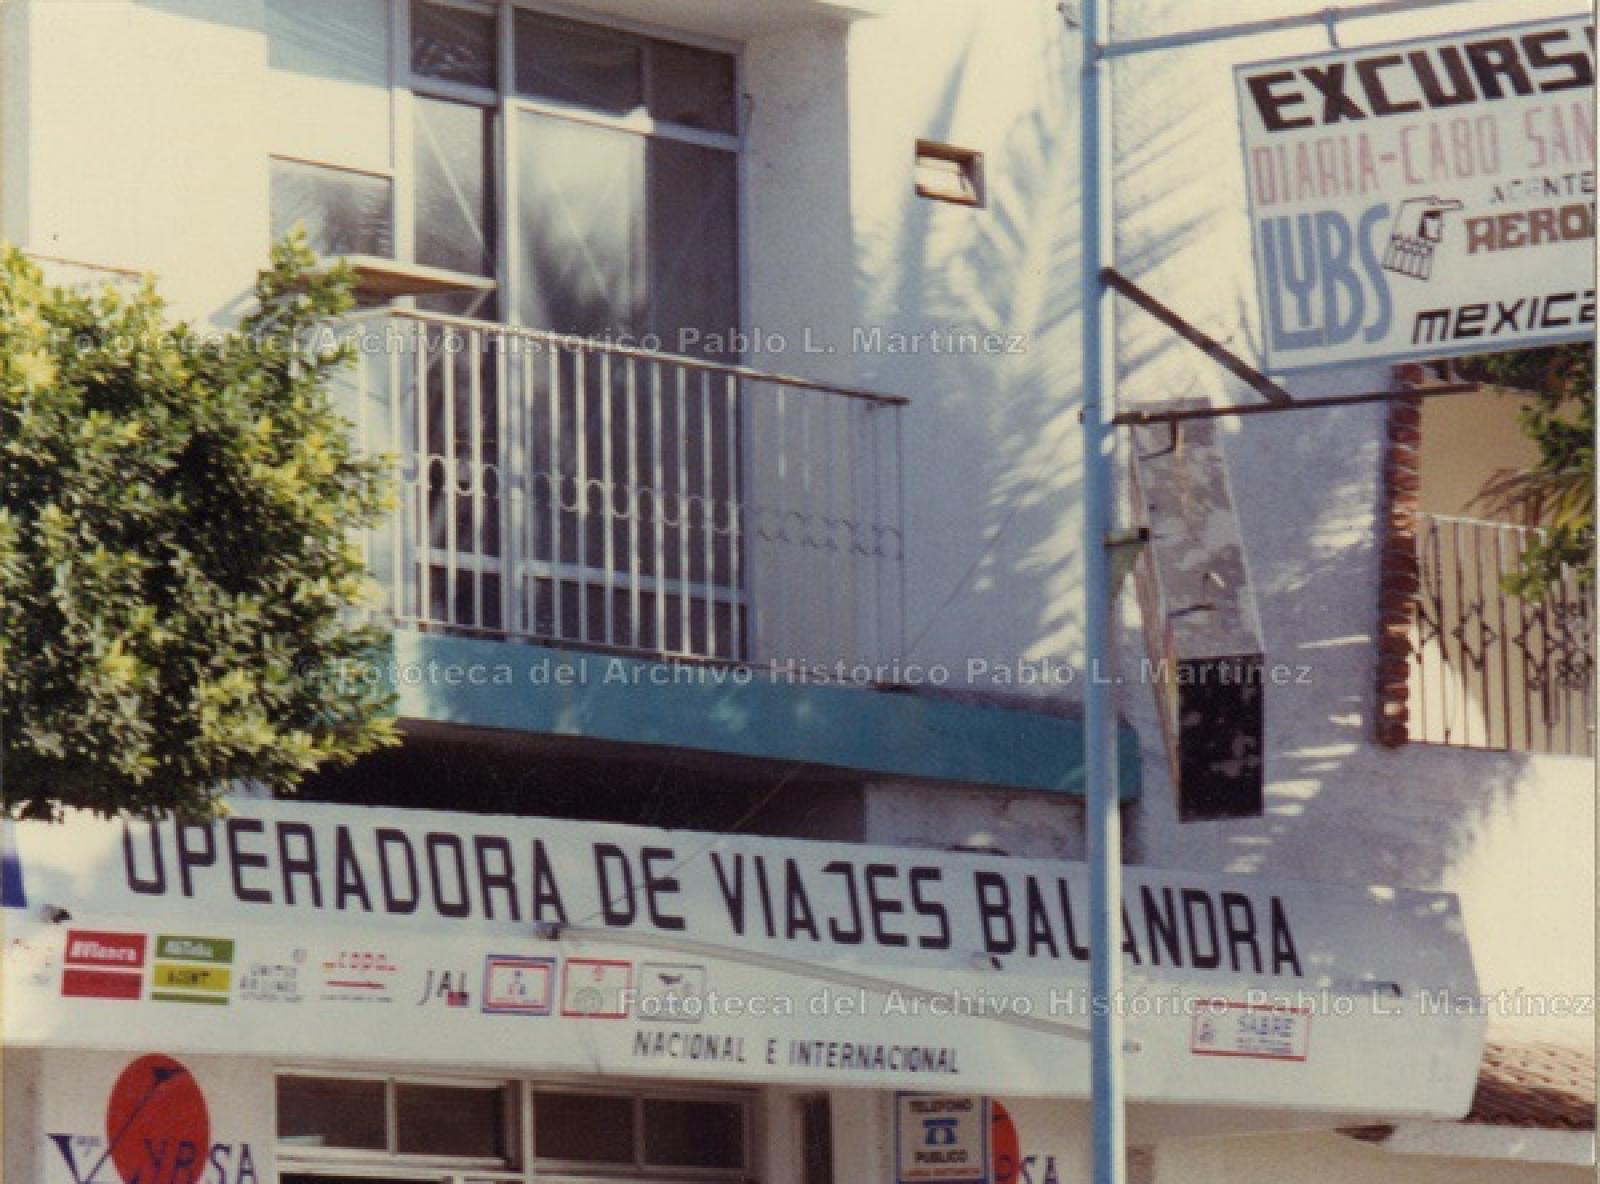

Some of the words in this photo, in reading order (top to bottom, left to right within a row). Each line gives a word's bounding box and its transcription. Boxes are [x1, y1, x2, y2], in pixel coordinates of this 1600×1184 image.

[1463, 200, 1596, 256] AERO
[1260, 204, 1393, 352] LYBS
[593, 842, 687, 931] DE
[709, 851, 953, 950] VIAJES
[632, 1030, 746, 1064] NACIONAL
[765, 1037, 777, 1065] E
[789, 1039, 960, 1075] INTERNACIONAL
